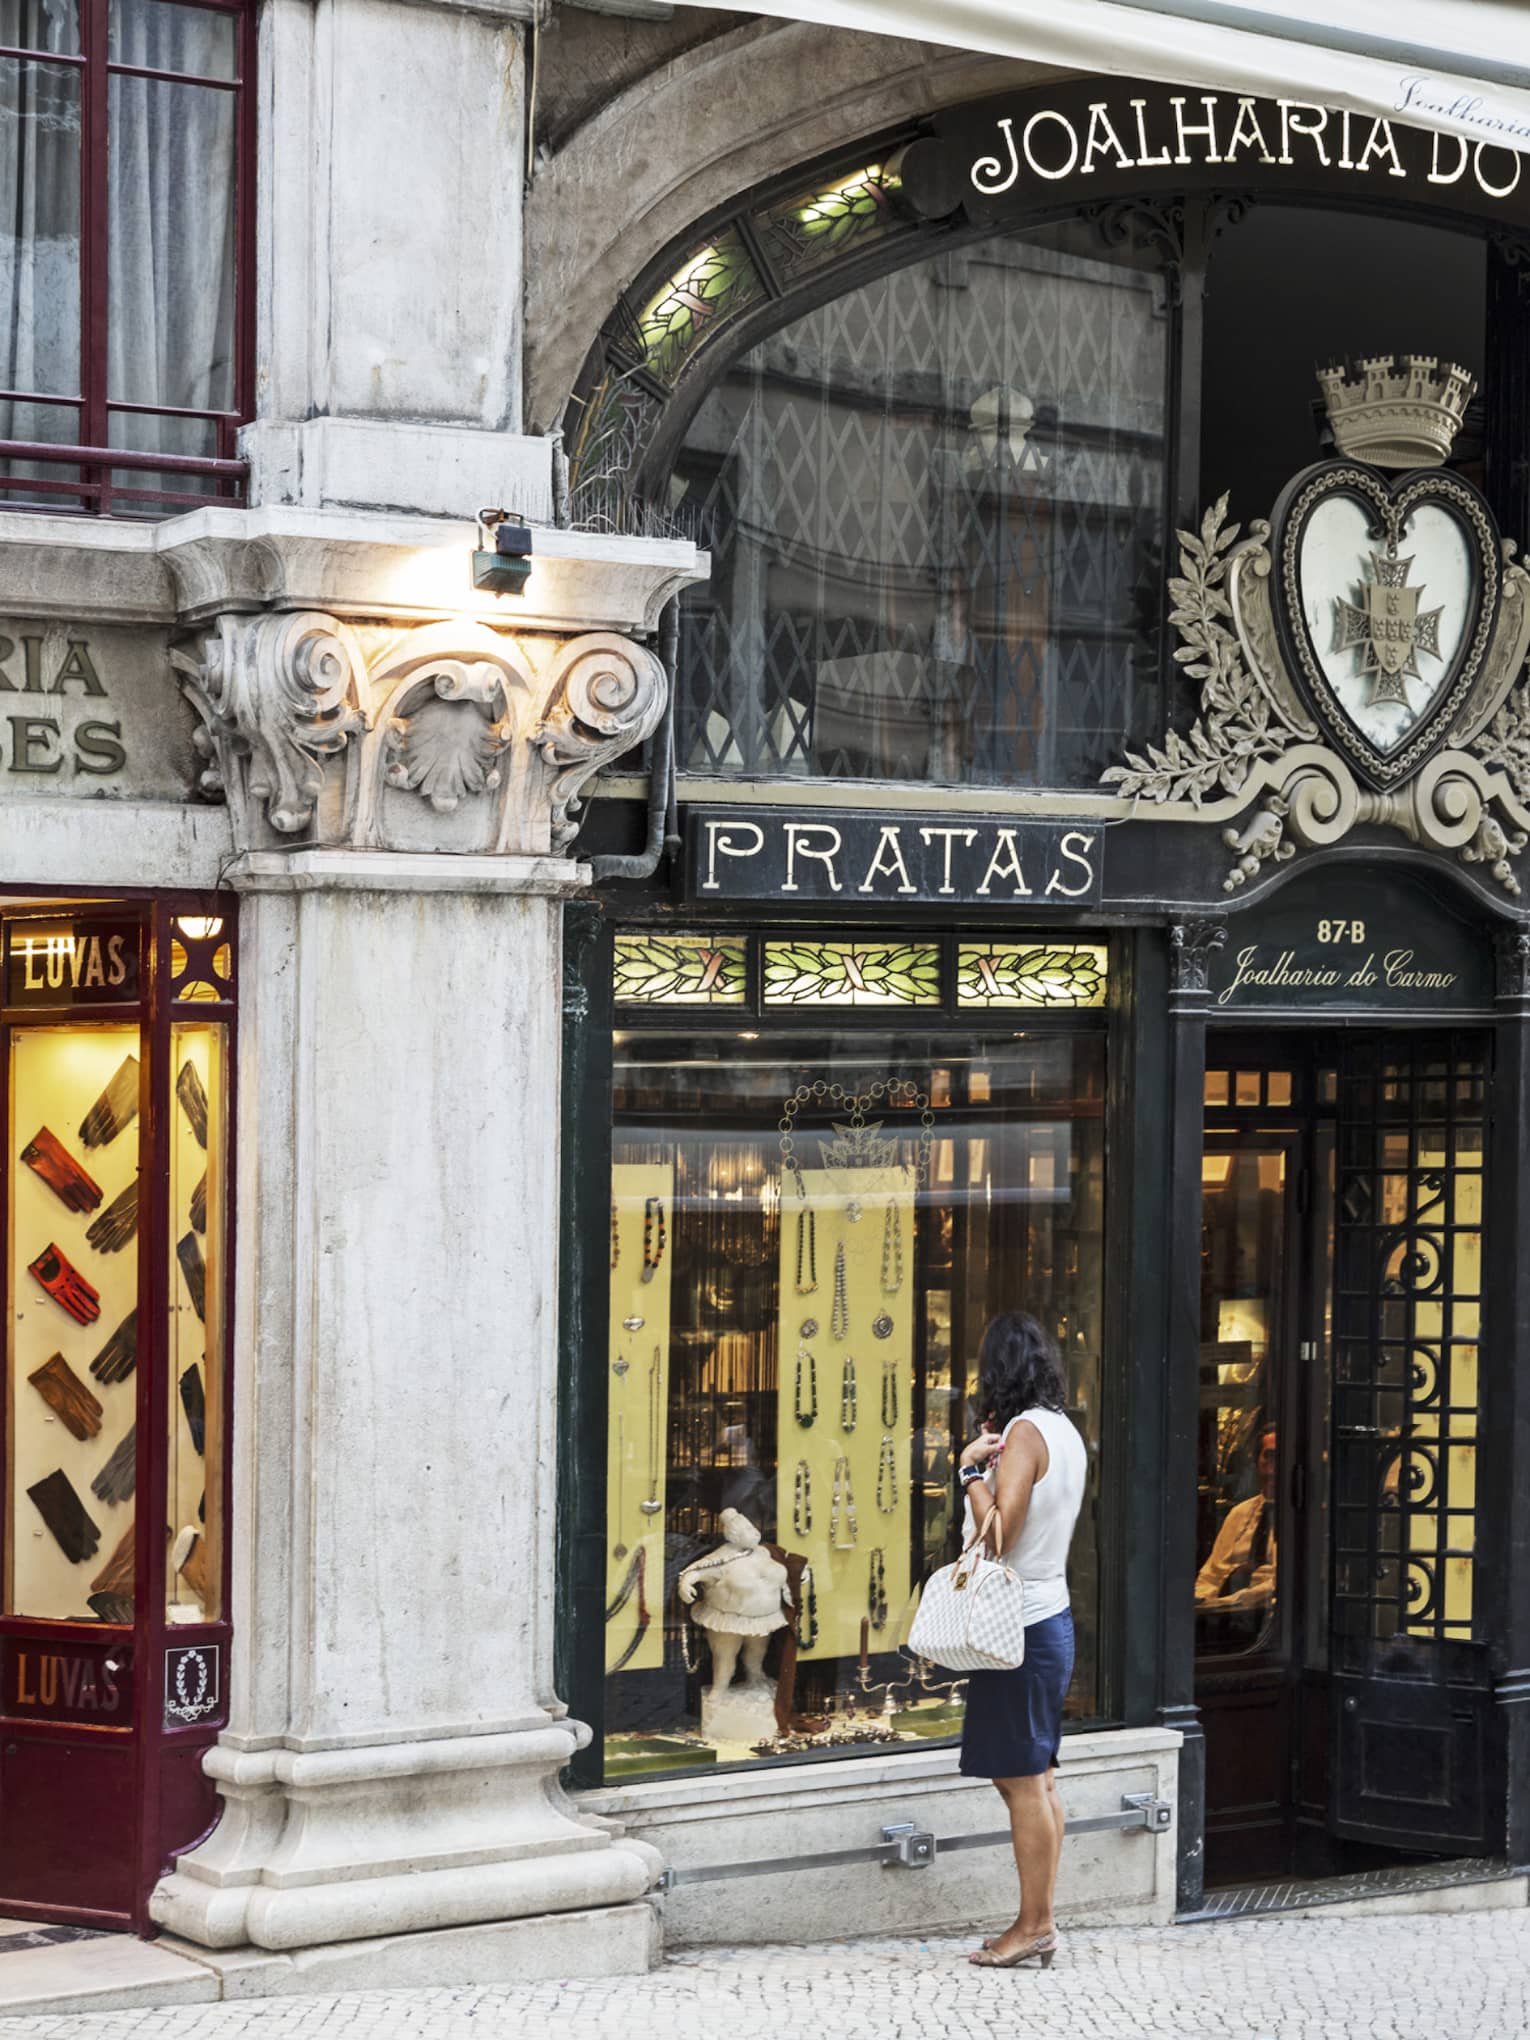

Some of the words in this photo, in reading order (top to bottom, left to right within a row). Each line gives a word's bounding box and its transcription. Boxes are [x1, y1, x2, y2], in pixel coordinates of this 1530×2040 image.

[970, 97, 1407, 194] JOALHARIA
[1427, 131, 1521, 198] DO
[702, 821, 1095, 897] PRATAS
[24, 934, 126, 990] LUVAS
[1218, 945, 1341, 1004] Joalharia
[1344, 953, 1378, 987] do
[1384, 949, 1457, 988] Carmo
[16, 1653, 120, 1711] LUVAS
